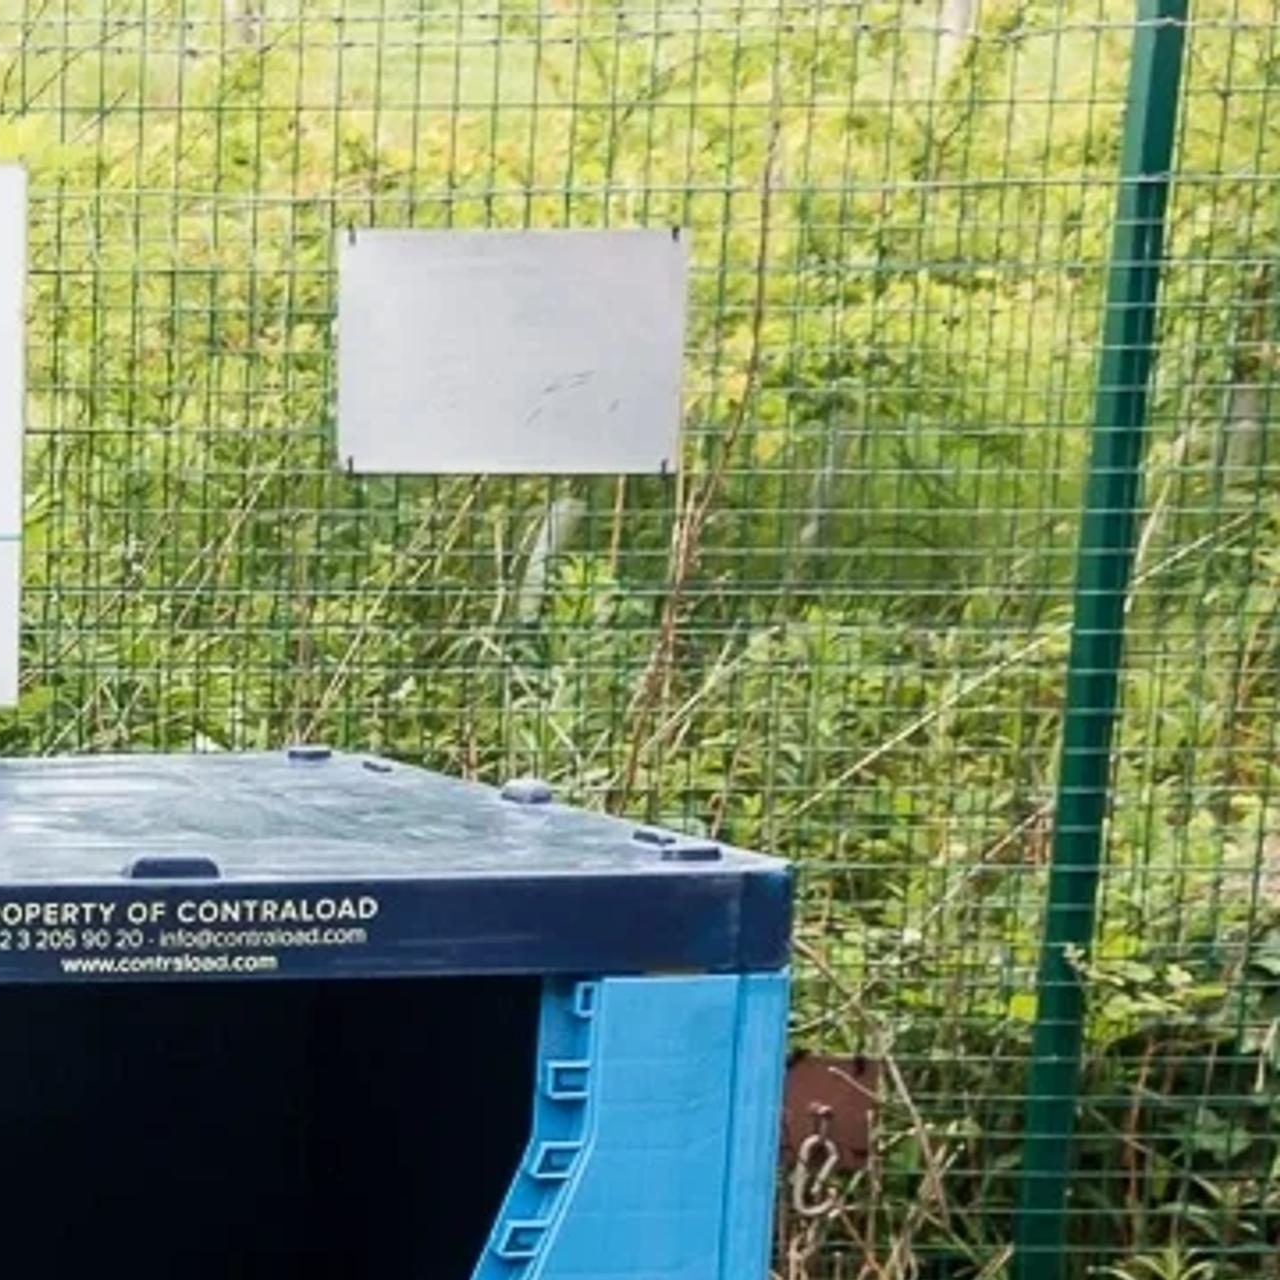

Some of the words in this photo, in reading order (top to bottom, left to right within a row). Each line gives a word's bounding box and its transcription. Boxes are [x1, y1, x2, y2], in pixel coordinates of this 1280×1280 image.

[127, 901, 166, 925] OF
[177, 896, 379, 923] CONTRALOAD
[17, 928, 31, 951] 3
[35, 928, 77, 951] 205
[81, 928, 111, 950] 90
[115, 928, 144, 950] 20
[159, 927, 367, 950] info@contraload.com
[60, 953, 278, 973] www.contraload.com
